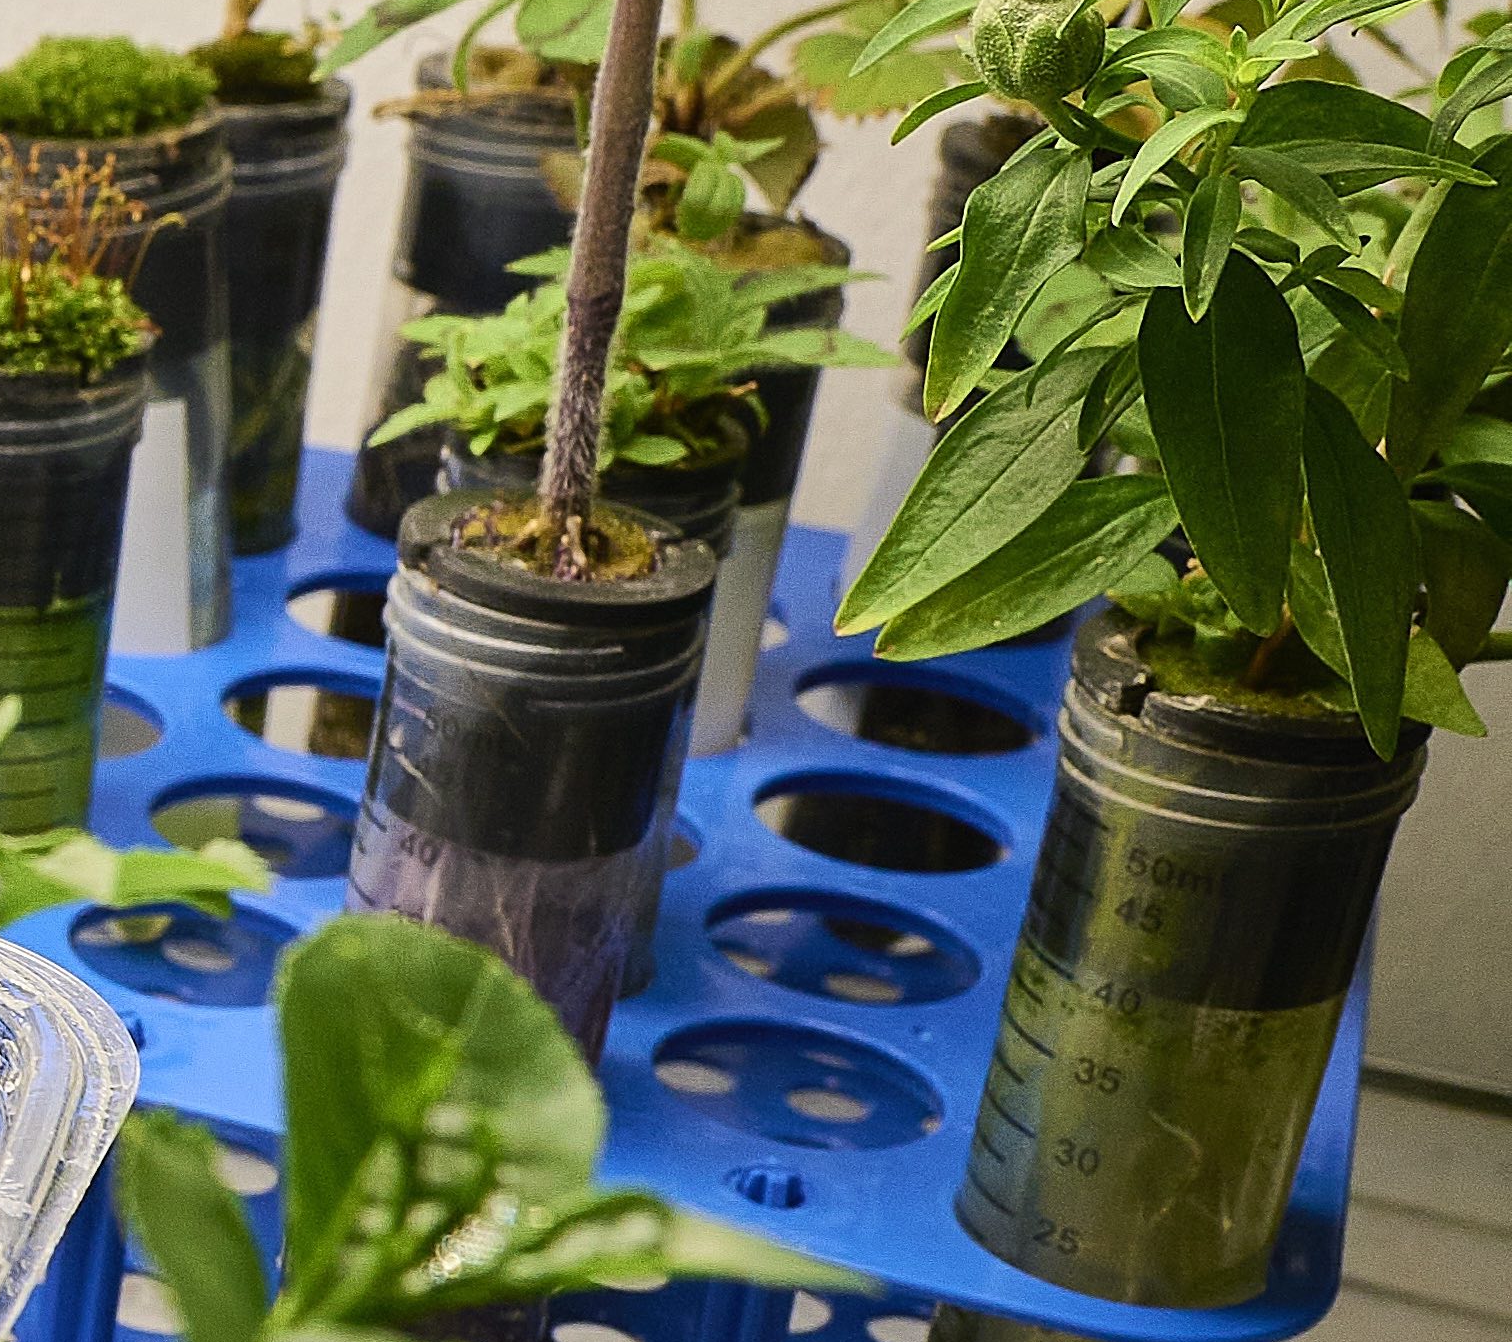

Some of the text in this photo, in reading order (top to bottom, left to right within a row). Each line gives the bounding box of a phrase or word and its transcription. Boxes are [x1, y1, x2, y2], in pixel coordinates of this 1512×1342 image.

[1095, 981, 1141, 1015] 40
[1075, 1059, 1121, 1095] 35
[1054, 1137, 1101, 1174] 30
